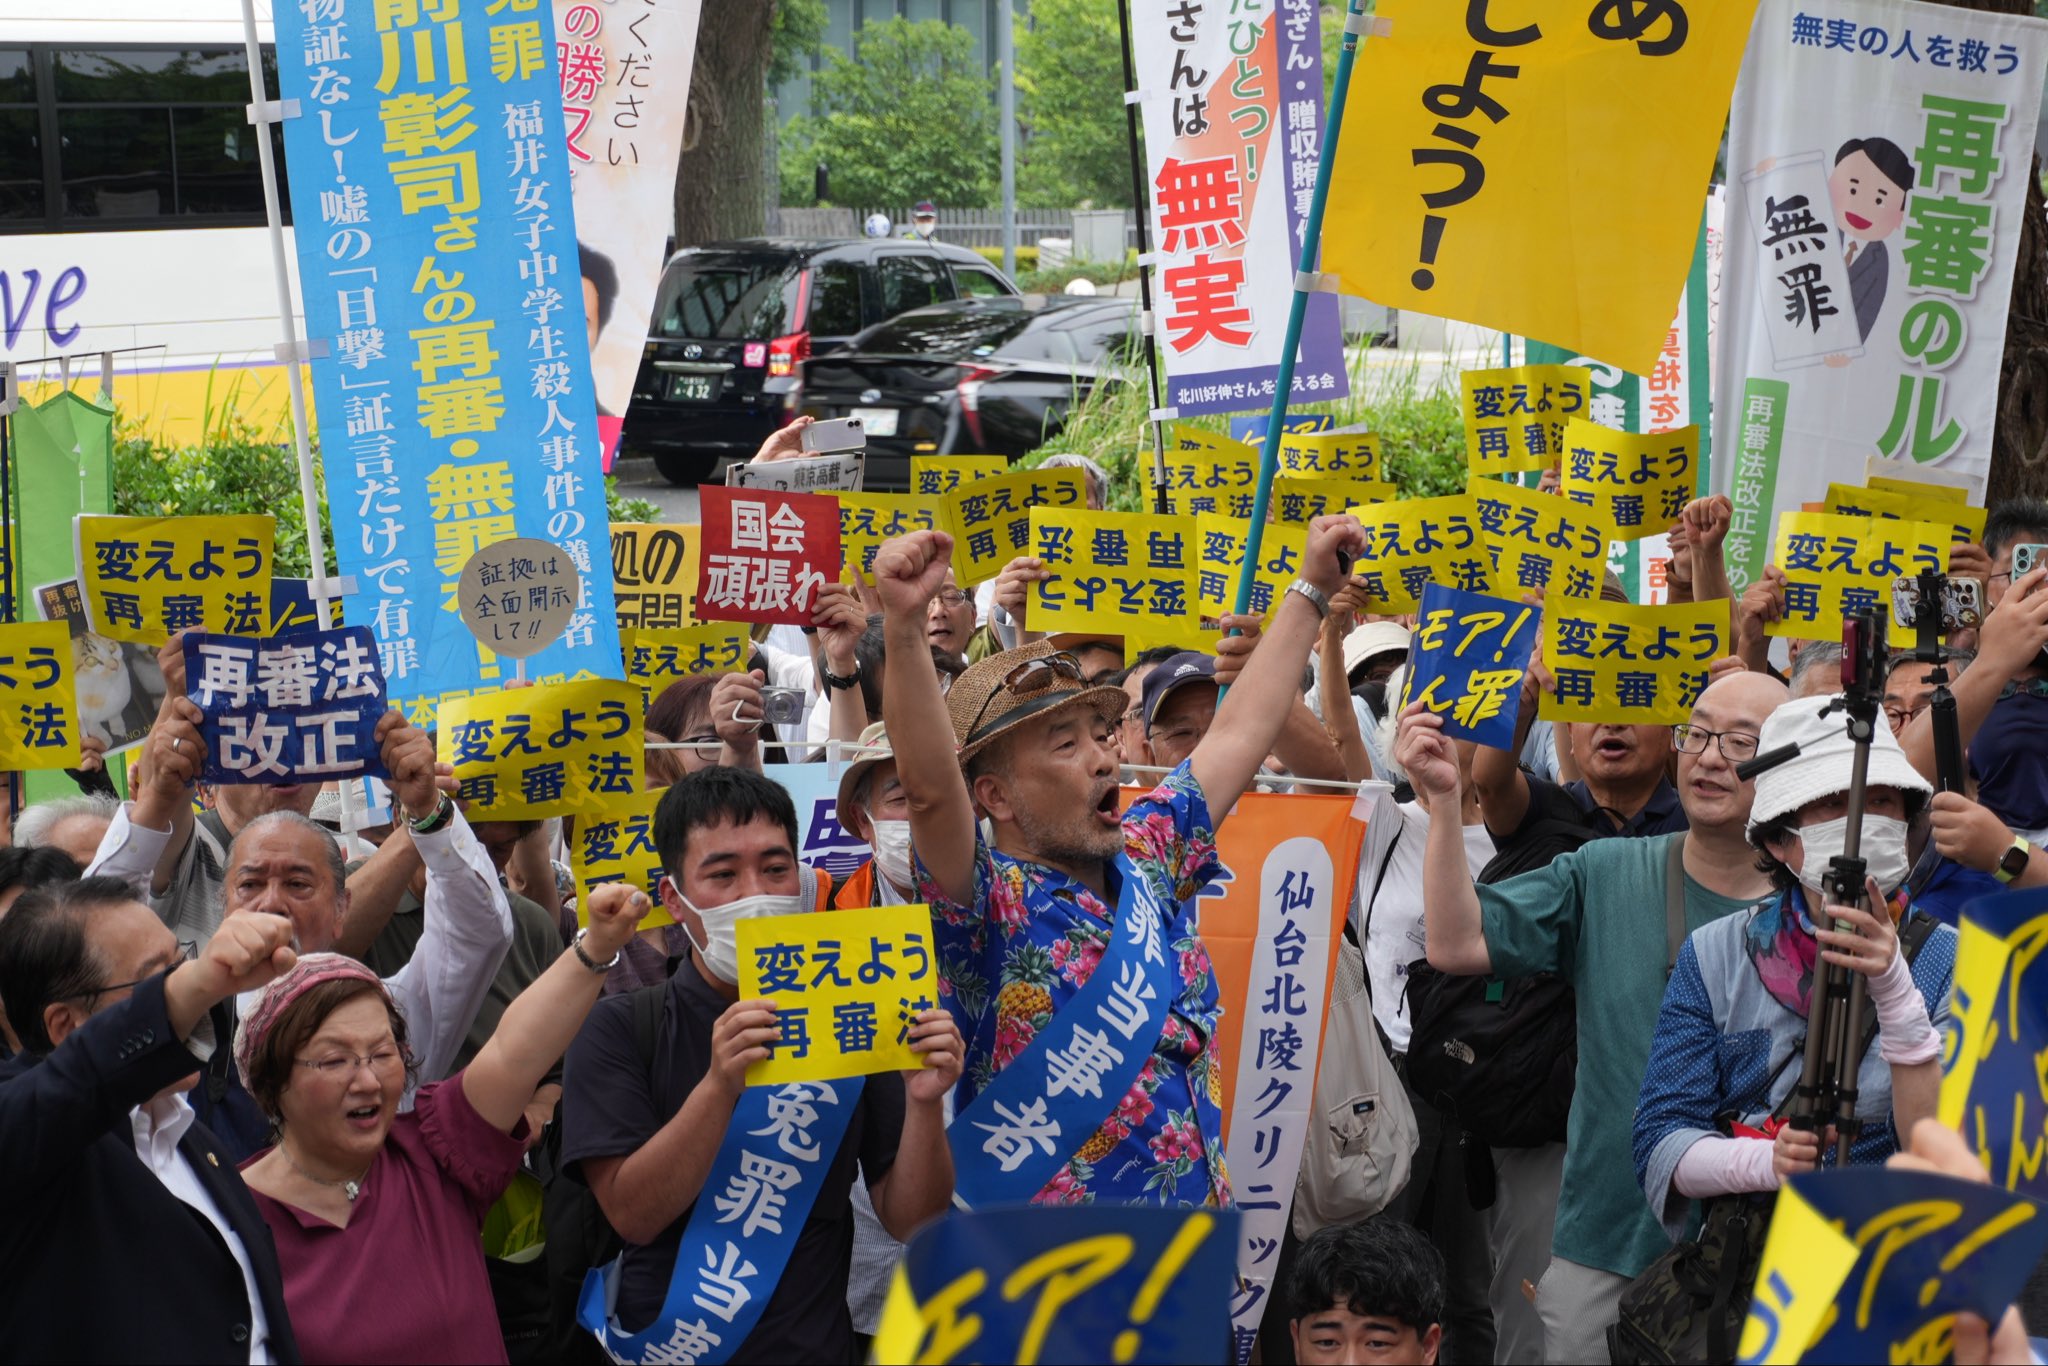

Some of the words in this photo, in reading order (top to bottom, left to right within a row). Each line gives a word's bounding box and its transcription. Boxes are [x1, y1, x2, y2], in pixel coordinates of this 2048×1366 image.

[1791, 12, 2020, 76] 無実の人を救う
[608, 0, 655, 167] ください
[1155, 156, 1253, 354] 無実
[1762, 194, 1839, 334] 無罪
[1876, 93, 2008, 465] 再審のル
[1178, 373, 1335, 405] 北川好伸さんをえる会
[1472, 382, 1583, 419] 変えよう
[1148, 462, 1254, 490] 変えよう
[1283, 445, 1374, 472] 変えよう
[1569, 446, 1689, 484] 変えよう
[919, 469, 1003, 496] 変え
[960, 481, 1078, 528] 変えよう
[1727, 394, 1776, 602] 再審法改正をめ
[731, 499, 806, 554] 国会
[1038, 524, 1185, 569] 再審法
[1477, 498, 1602, 559] 変えよう
[95, 538, 264, 583] 変えよう
[478, 557, 560, 587] 証拠は
[1785, 532, 1941, 578] 変えよう
[474, 586, 571, 619] 全面開示
[703, 554, 826, 613] 頑張れ
[1038, 574, 1187, 617] 変えよう
[104, 591, 263, 636] 再審法
[630, 636, 742, 678] 変えよう
[1556, 617, 1721, 661] 変えよう
[198, 636, 380, 708] 再審法
[1174, 665, 1200, 677] adidas
[20, 702, 68, 748] 法
[218, 710, 365, 779] 改正
[451, 701, 632, 766] 変えよう
[457, 752, 635, 808] 再審法
[754, 933, 929, 996] 変えよう
[971, 853, 1166, 1172] 罪当事者
[602, 1079, 839, 1366] 冤罪当事
